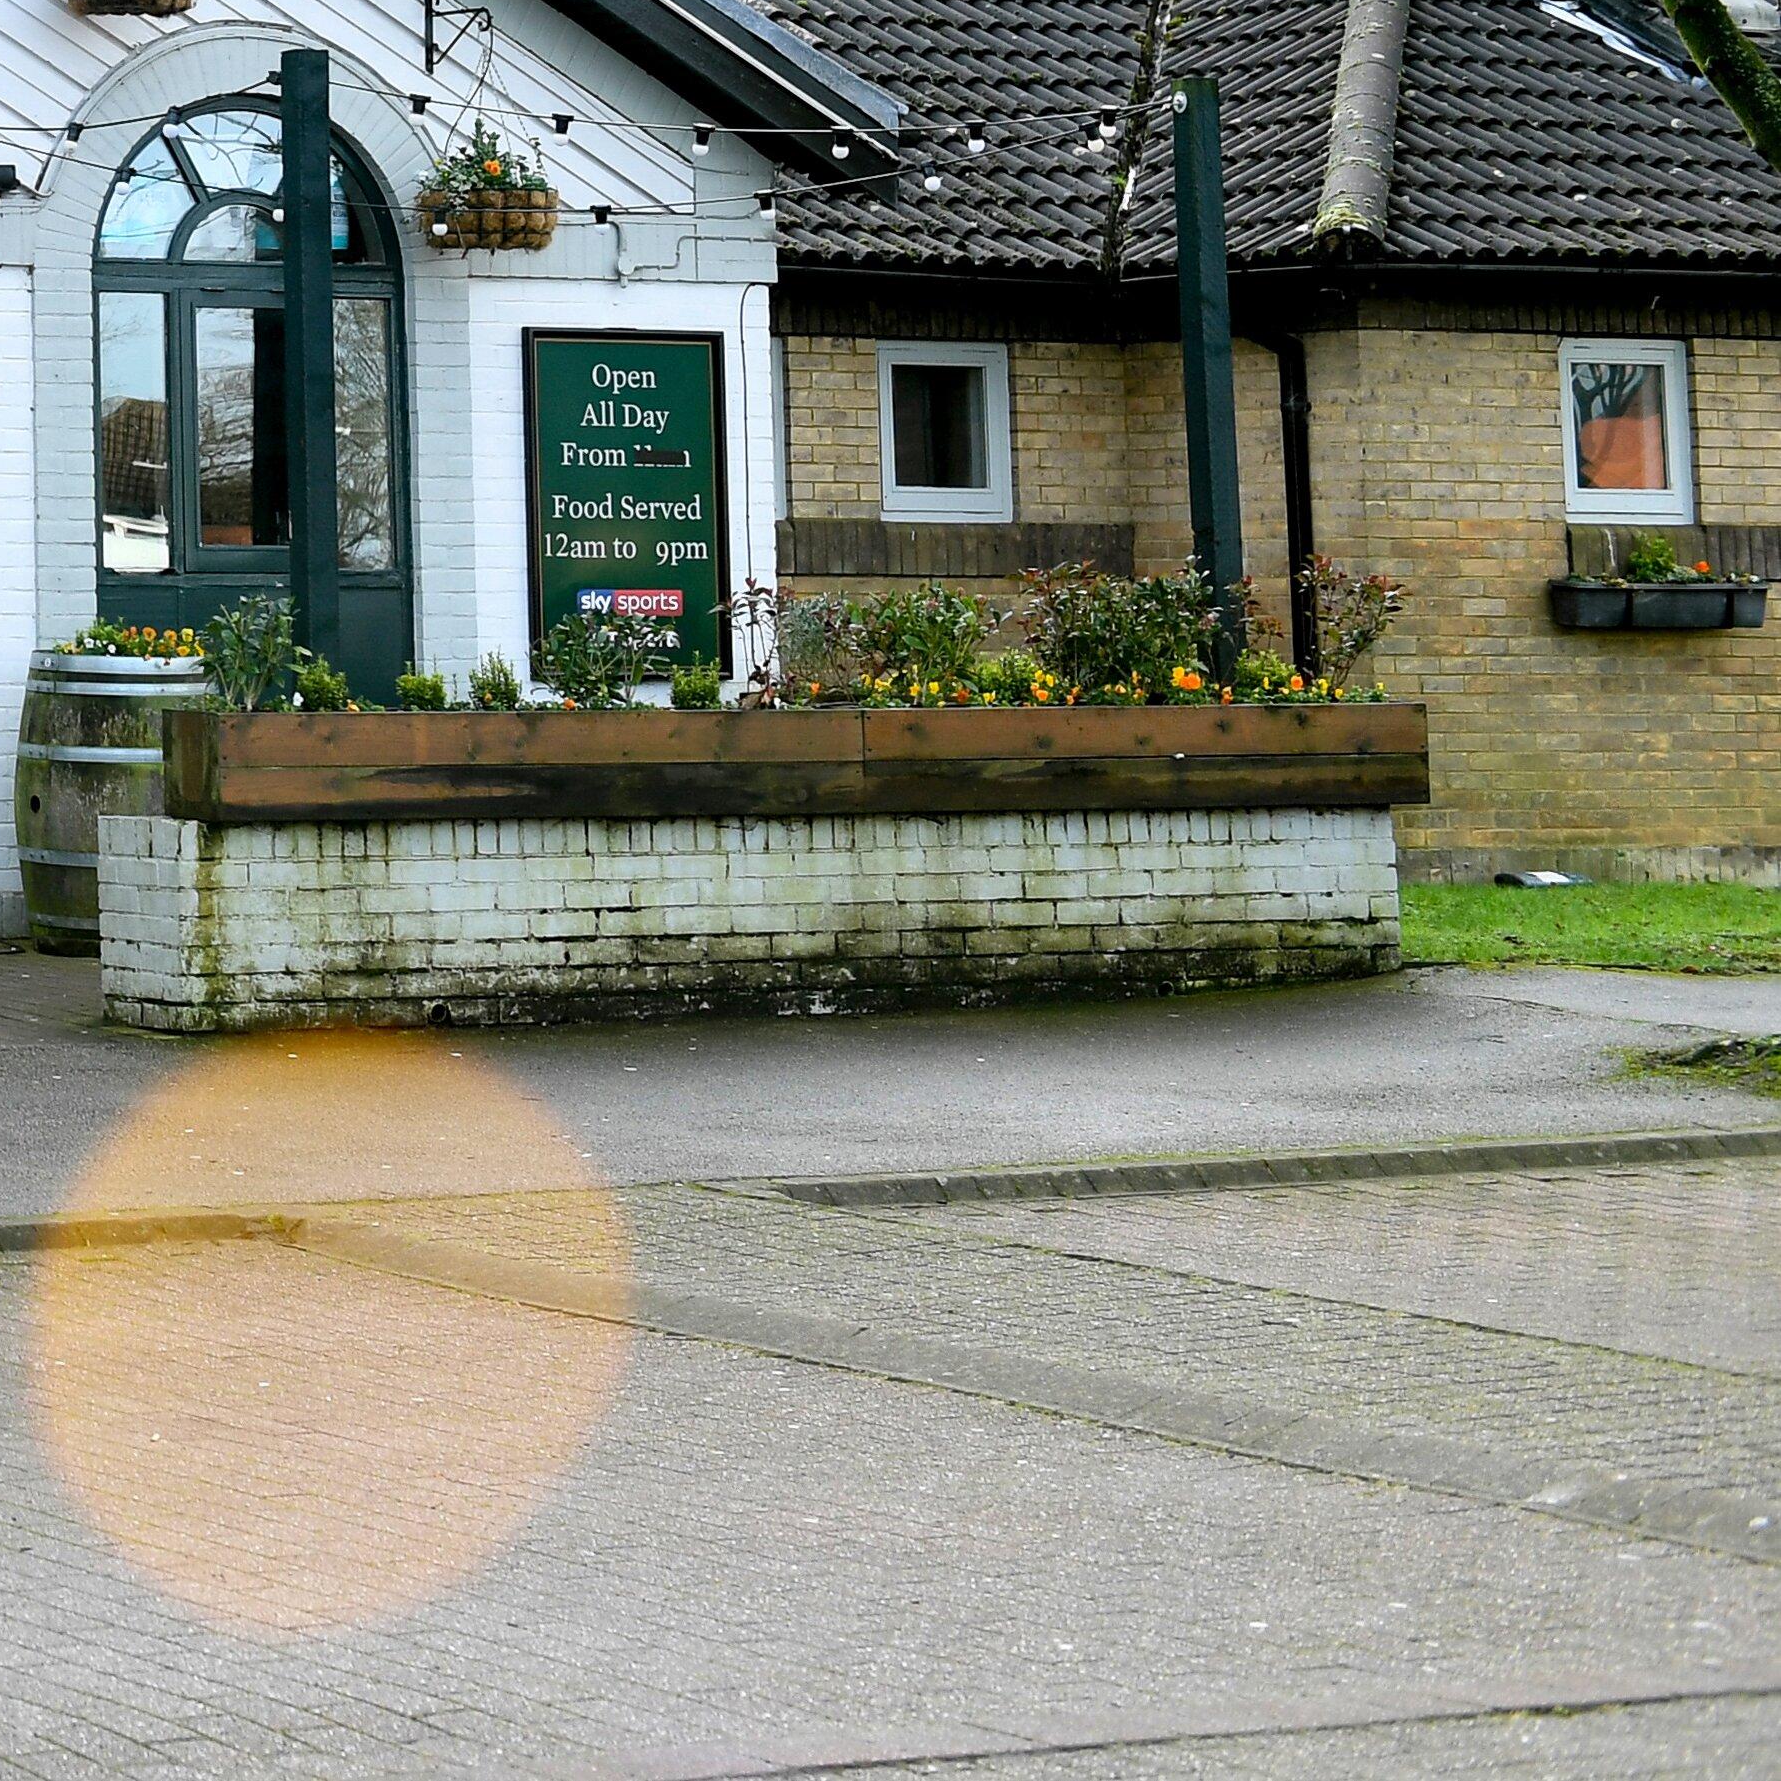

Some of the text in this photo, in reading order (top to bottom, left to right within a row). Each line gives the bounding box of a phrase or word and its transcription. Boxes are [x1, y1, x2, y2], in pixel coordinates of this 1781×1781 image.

[591, 363, 657, 395] Open
[579, 400, 670, 435] All Day
[560, 441, 628, 467] From
[551, 492, 703, 520] Food Served
[544, 533, 709, 567] 12am to 9pm
[580, 590, 680, 616] sky sports
